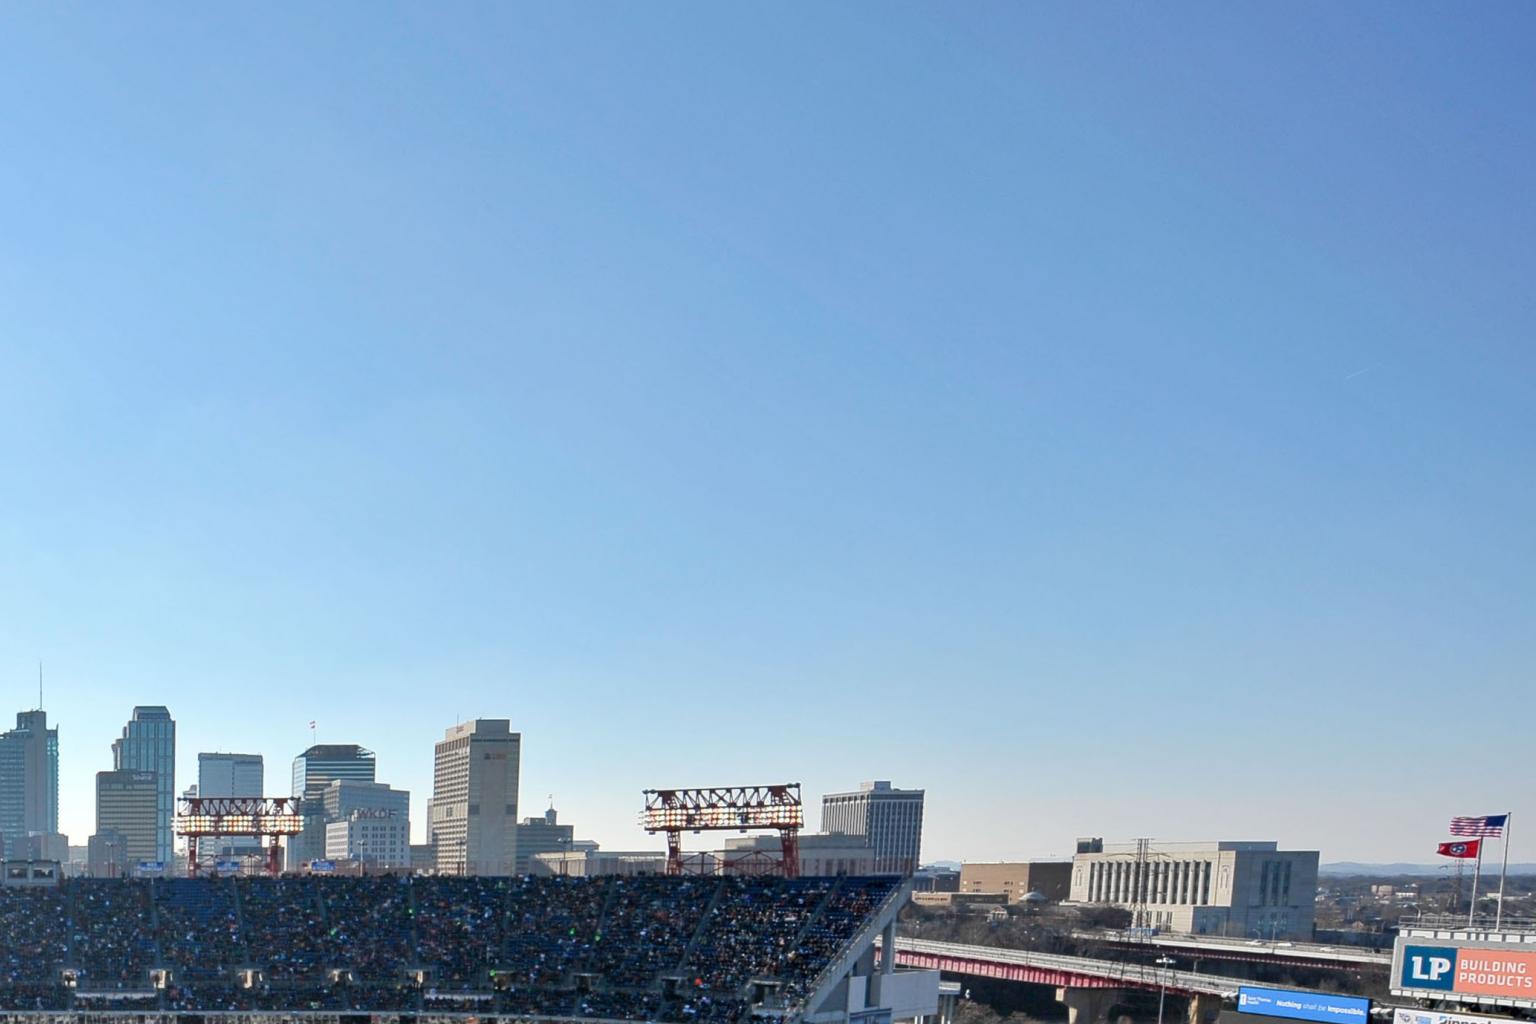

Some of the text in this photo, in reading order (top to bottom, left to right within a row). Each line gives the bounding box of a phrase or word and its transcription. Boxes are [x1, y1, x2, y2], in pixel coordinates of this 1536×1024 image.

[1411, 956, 1528, 981] LP BUILDING
[1458, 973, 1533, 988] PRODUCTS
[1276, 1000, 1302, 1010] Nothing
